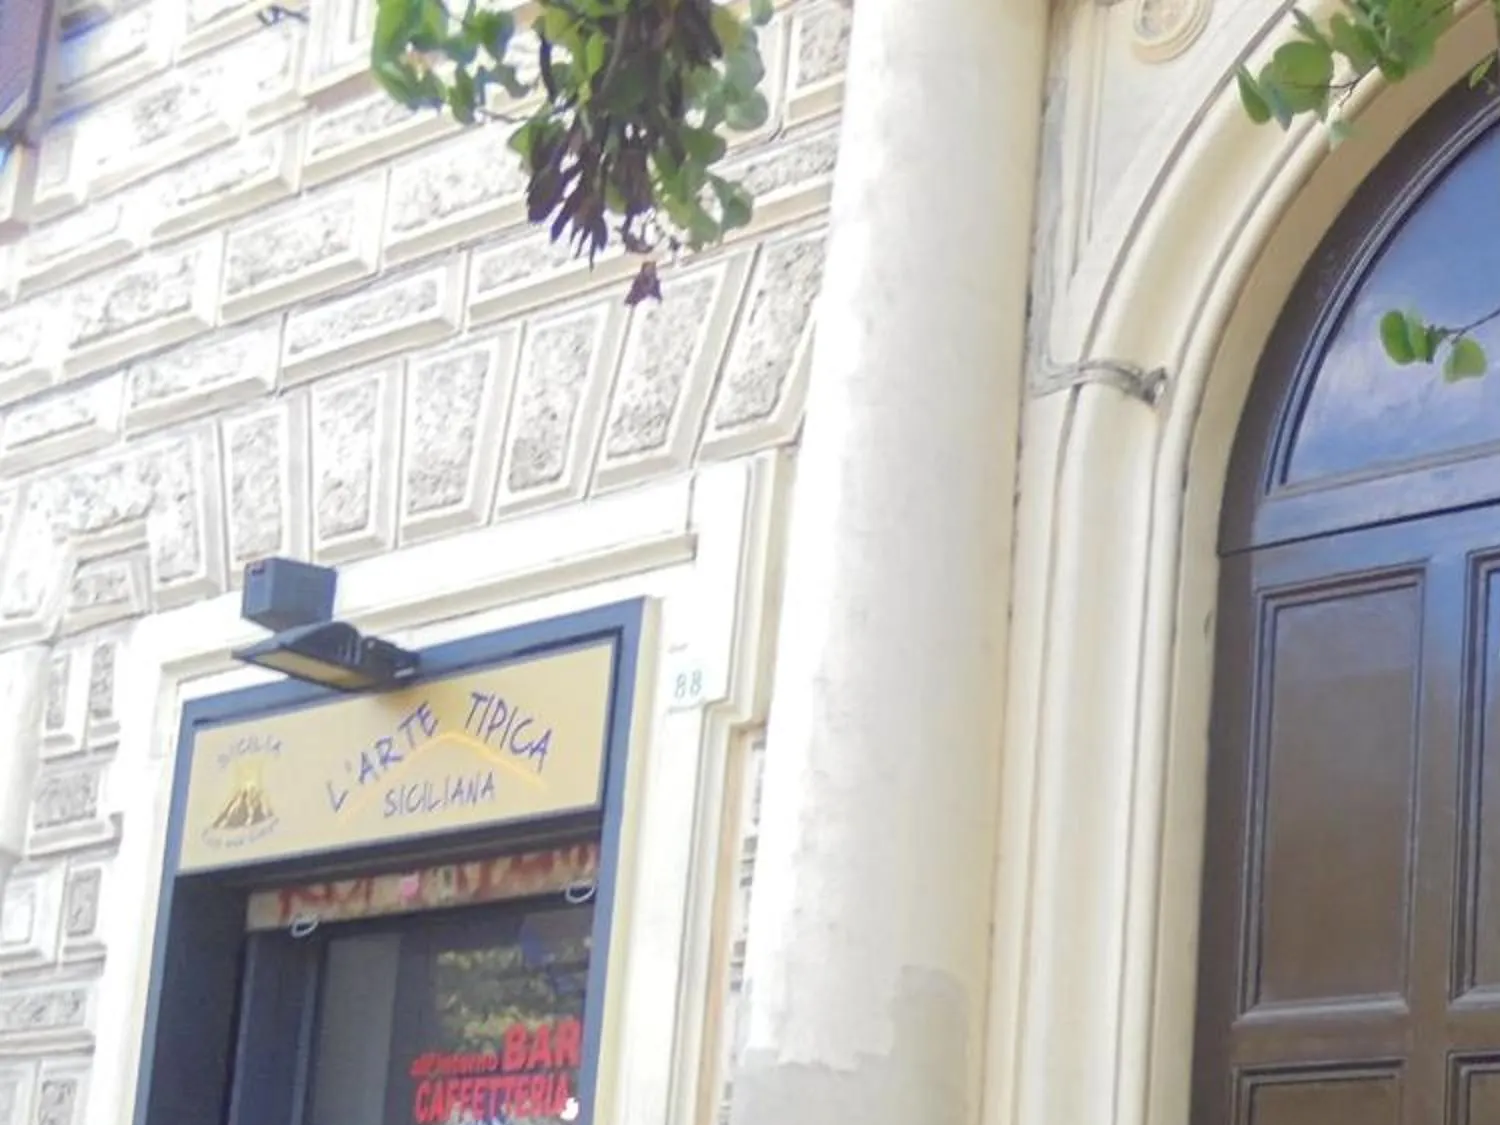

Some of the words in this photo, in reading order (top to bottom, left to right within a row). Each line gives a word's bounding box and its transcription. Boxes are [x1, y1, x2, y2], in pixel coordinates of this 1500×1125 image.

[674, 668, 703, 699] 88
[326, 701, 440, 813] L'ARTE
[464, 692, 553, 776] TIPICA
[383, 771, 496, 819] SICILIANA
[502, 1018, 581, 1072] BAR
[414, 1070, 571, 1124] CAFFETTERIA
